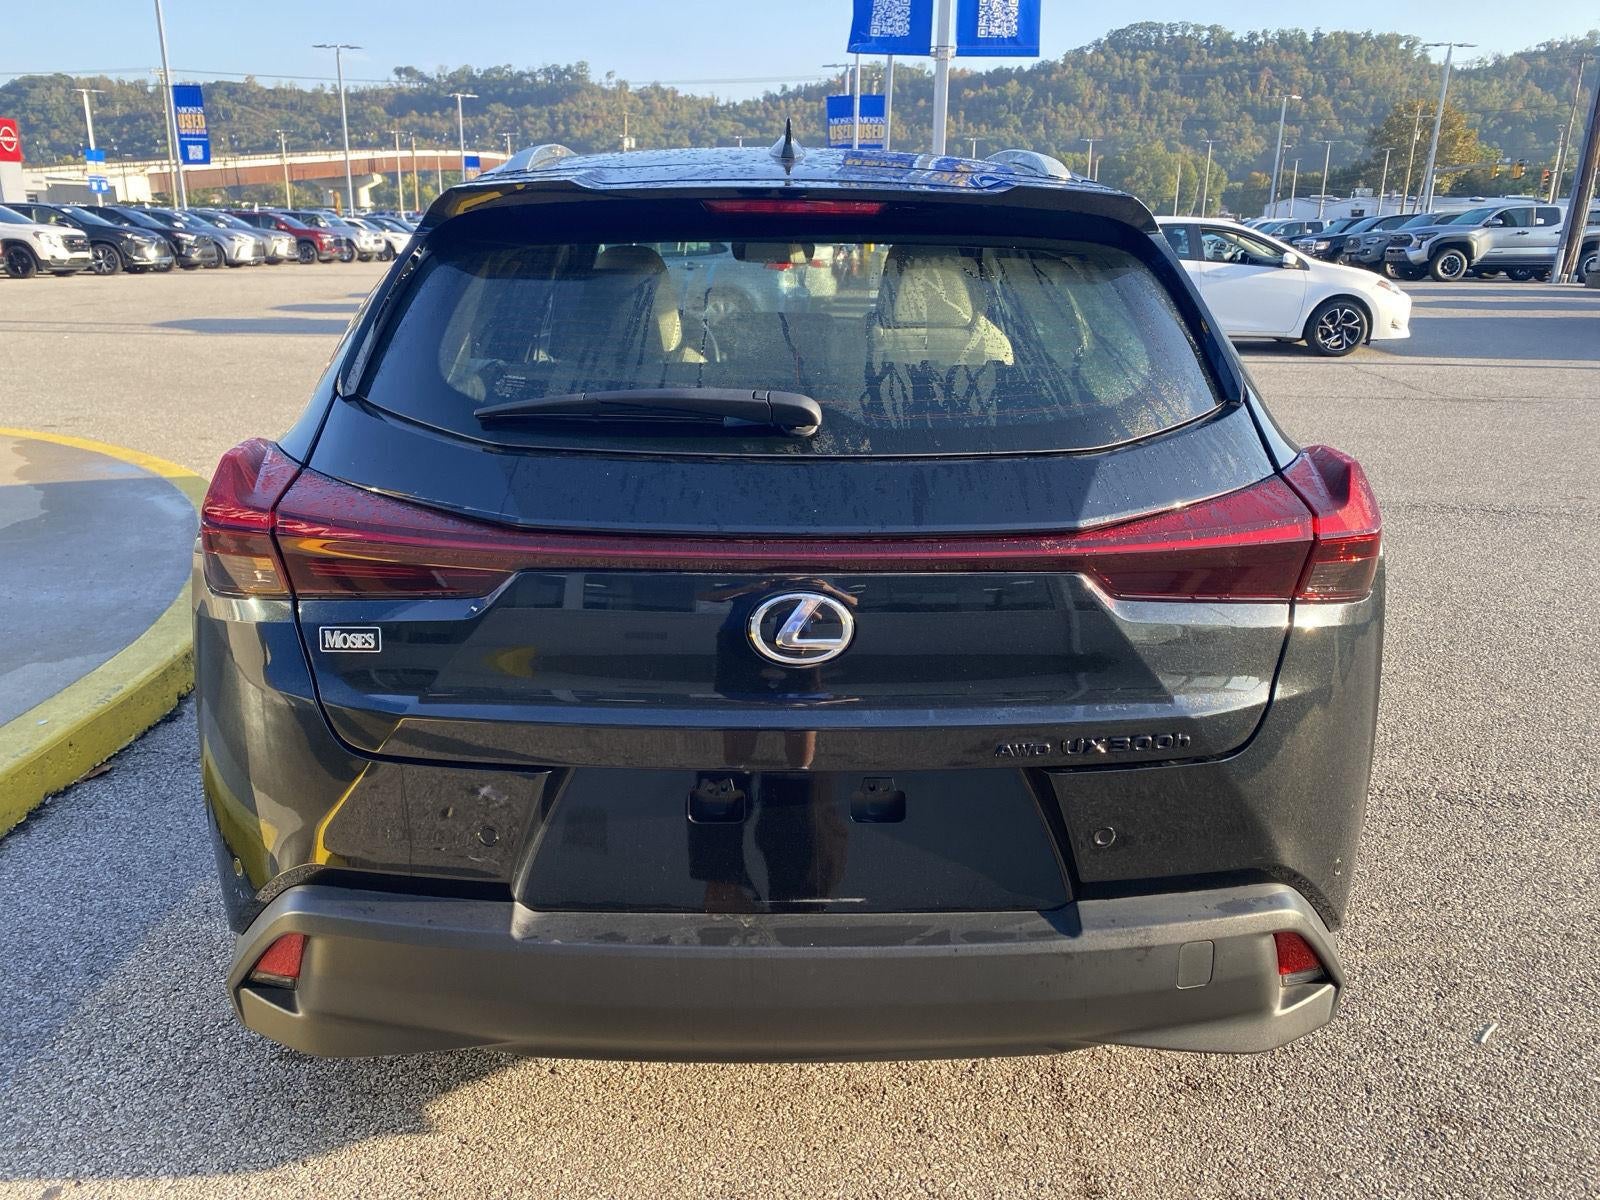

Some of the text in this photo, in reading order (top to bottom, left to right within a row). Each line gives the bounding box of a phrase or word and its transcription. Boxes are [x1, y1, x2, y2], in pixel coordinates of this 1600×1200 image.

[178, 113, 205, 129] USED
[858, 123, 885, 139] USED
[324, 630, 376, 649] MOSES
[995, 743, 1051, 757] AWD
